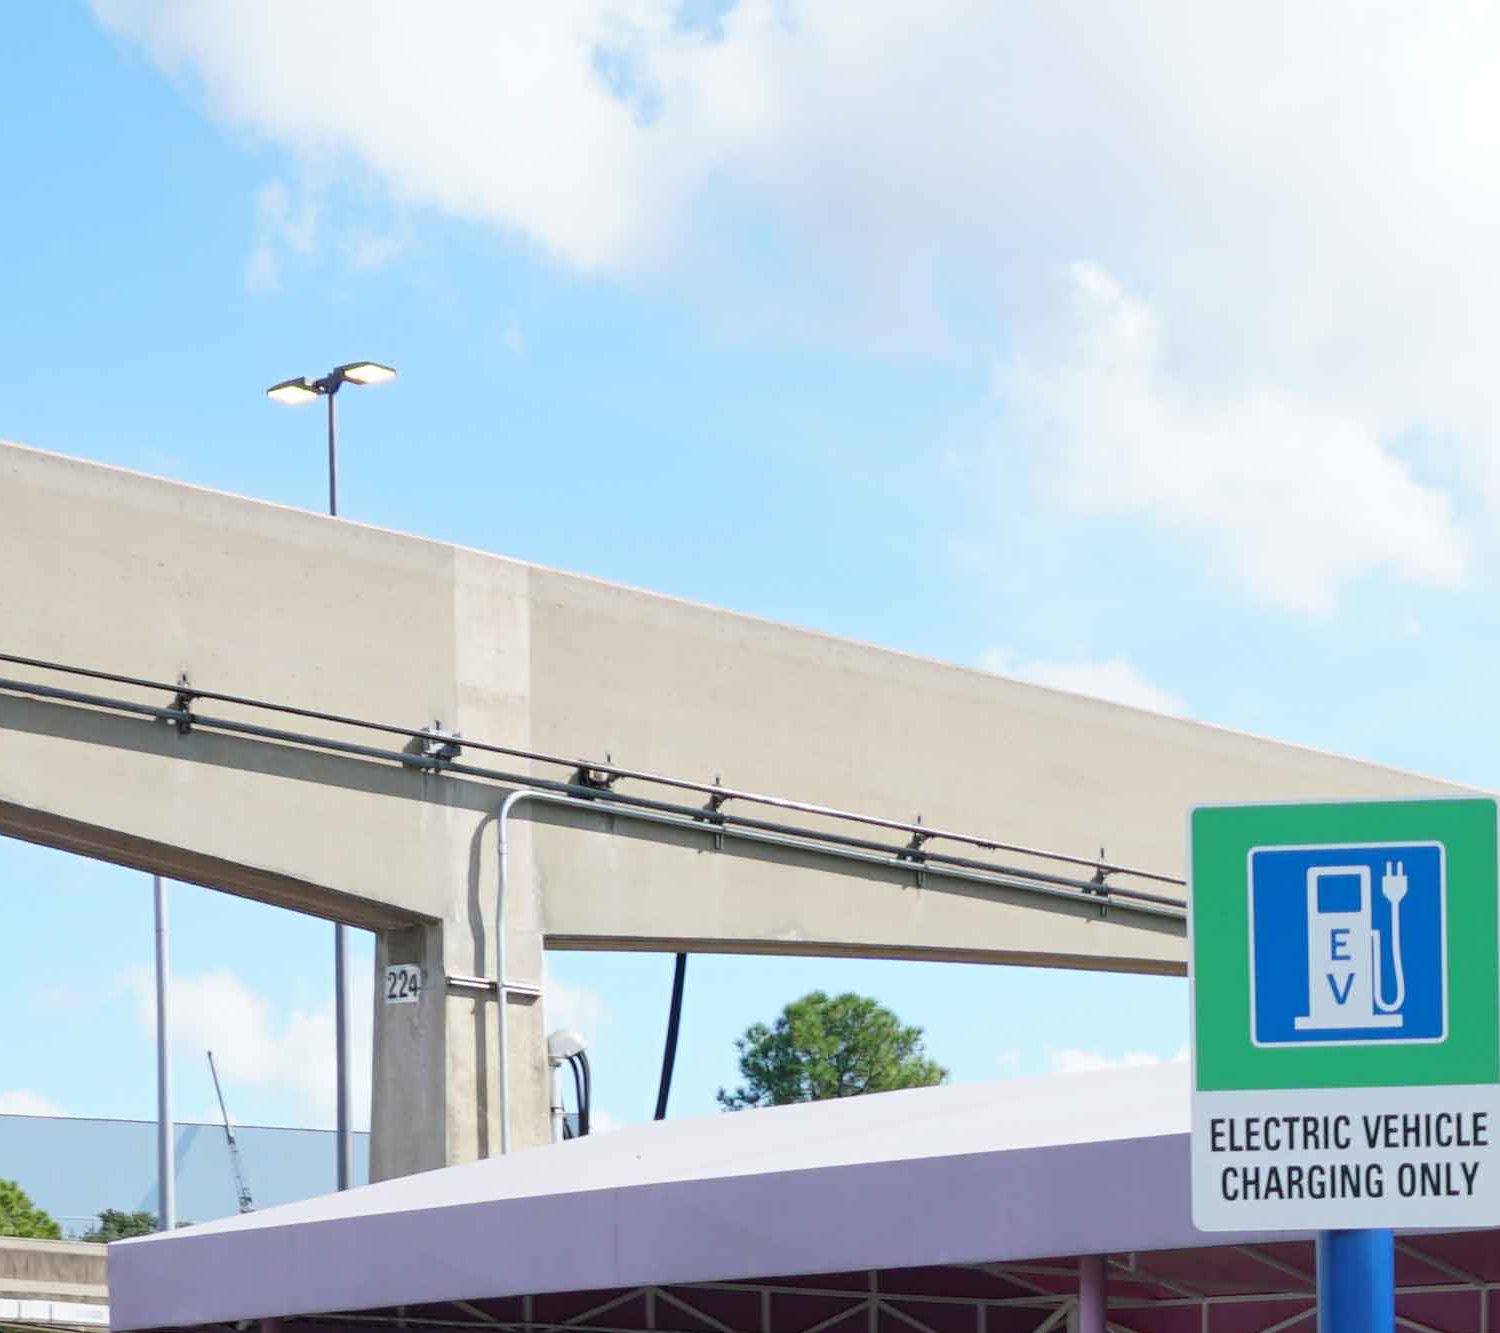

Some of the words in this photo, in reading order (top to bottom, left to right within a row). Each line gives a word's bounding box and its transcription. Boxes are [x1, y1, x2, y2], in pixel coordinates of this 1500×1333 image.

[387, 969, 418, 999] 224
[1210, 1115, 1351, 1152] ELECTRIC
[1363, 1112, 1488, 1149] VEHICLE
[1221, 1163, 1384, 1201] CHARGING
[1397, 1161, 1480, 1198] ONLY
